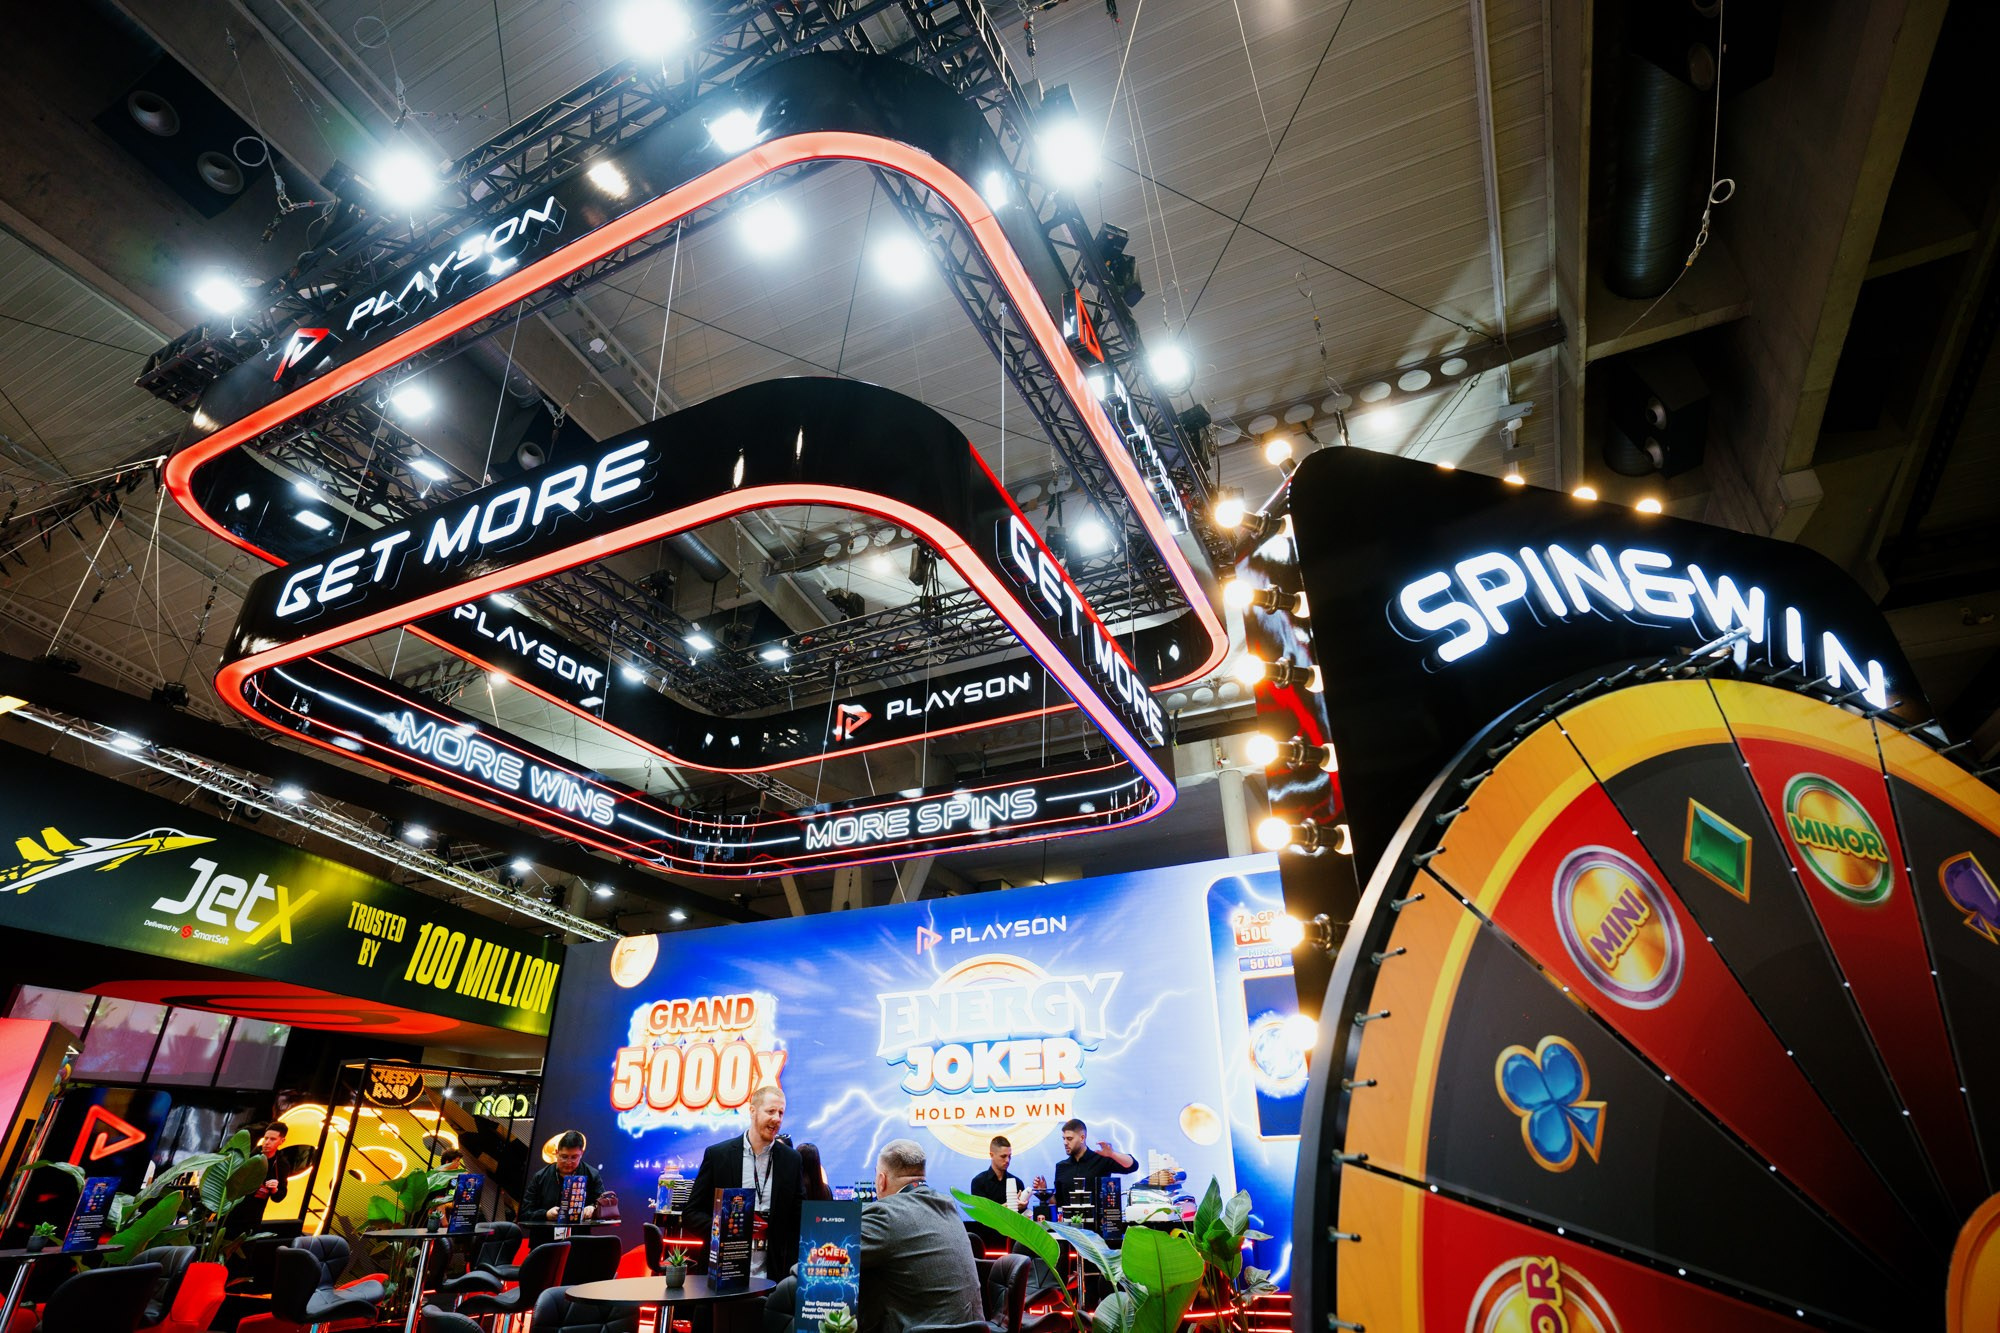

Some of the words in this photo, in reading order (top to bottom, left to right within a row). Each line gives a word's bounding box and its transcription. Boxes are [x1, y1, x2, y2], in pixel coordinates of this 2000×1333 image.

[346, 195, 555, 331] PLAYSON
[276, 530, 411, 618] GET
[422, 438, 650, 566] MORE
[453, 602, 604, 691] PLAYSON
[1010, 514, 1084, 636] GET
[1093, 621, 1165, 747] MORE
[886, 671, 1031, 721] PLAYSON
[396, 711, 525, 791] MORE
[530, 765, 616, 826] WINS
[806, 808, 911, 851] MORE
[917, 788, 1038, 833] SPINS
[1790, 814, 1886, 862] MINOR
[144, 919, 173, 932] Delivered
[172, 926, 181, 934] by
[151, 857, 320, 945] JetX
[347, 900, 407, 944] TRUSTED
[1589, 887, 1646, 962] MINI
[193, 929, 230, 945] SmartSoft
[357, 937, 382, 968] BY
[950, 914, 1067, 945] PLAYSON
[403, 921, 467, 990] 100
[455, 937, 560, 1015] MILLION
[1249, 956, 1283, 970] 50.00
[647, 996, 756, 1031] GRAND
[880, 974, 1120, 1053] ENERGY
[904, 1037, 1086, 1093] JOKER
[915, 1105, 966, 1121] HOLD
[975, 1104, 1016, 1119] AND
[1030, 1102, 1066, 1117] WIN
[810, 1248, 848, 1258] POWER
